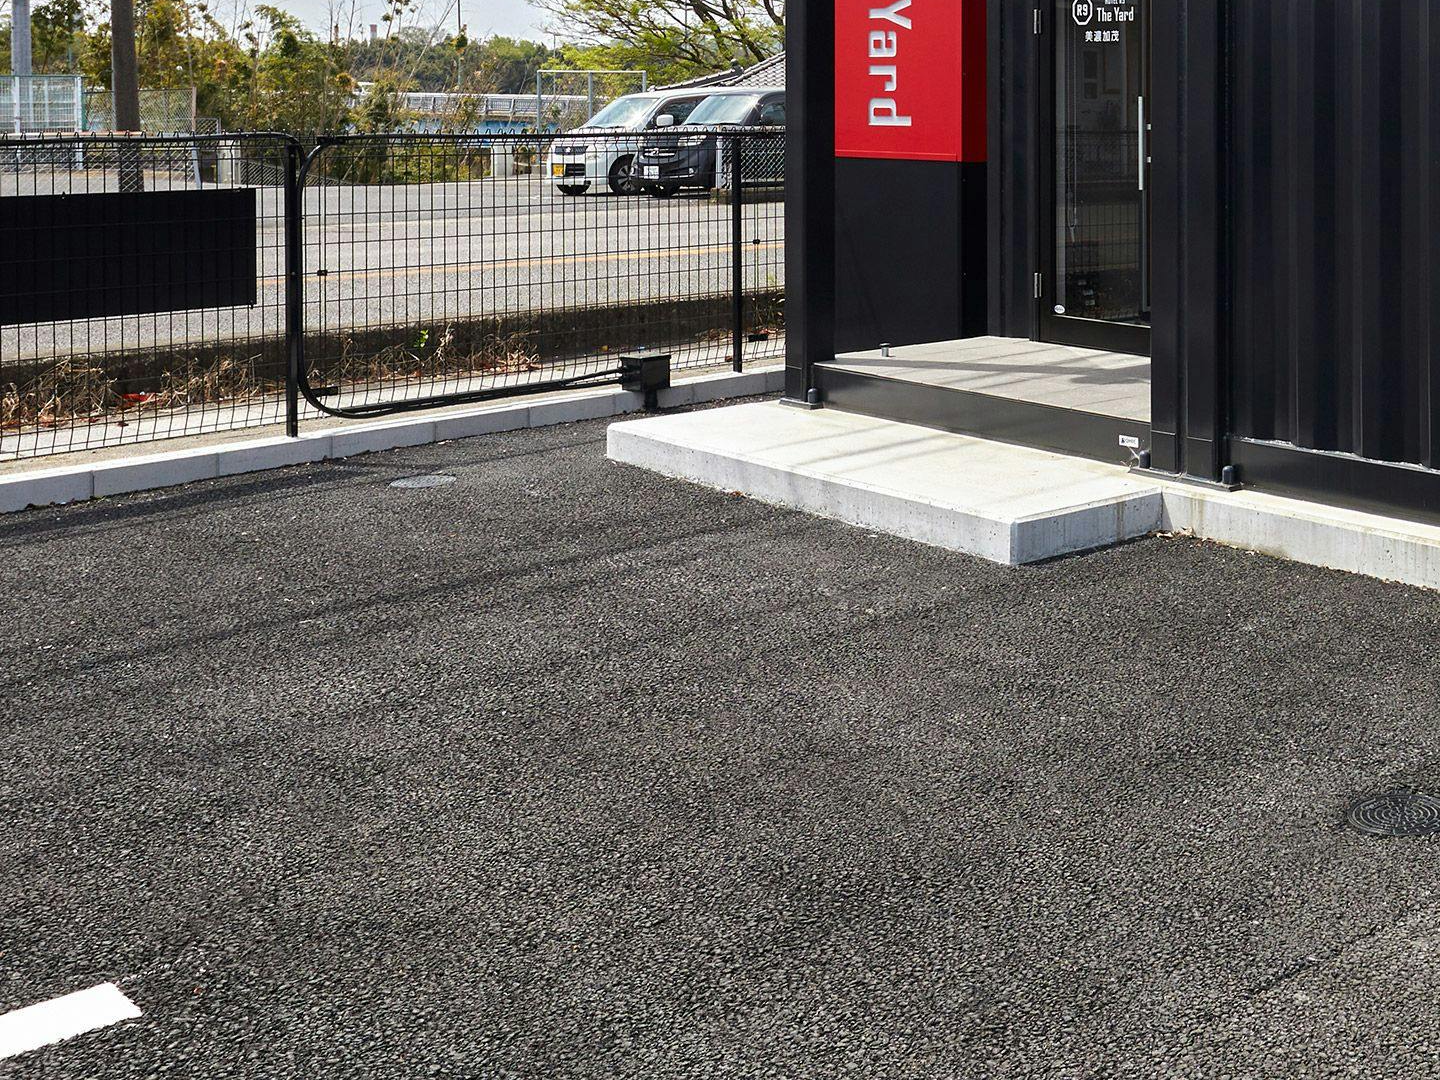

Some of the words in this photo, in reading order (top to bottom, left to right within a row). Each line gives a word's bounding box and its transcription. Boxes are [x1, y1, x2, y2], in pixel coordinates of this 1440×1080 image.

[1076, 3, 1089, 17] R9
[1096, 6, 1112, 22] The
[1113, 6, 1134, 22] Yard
